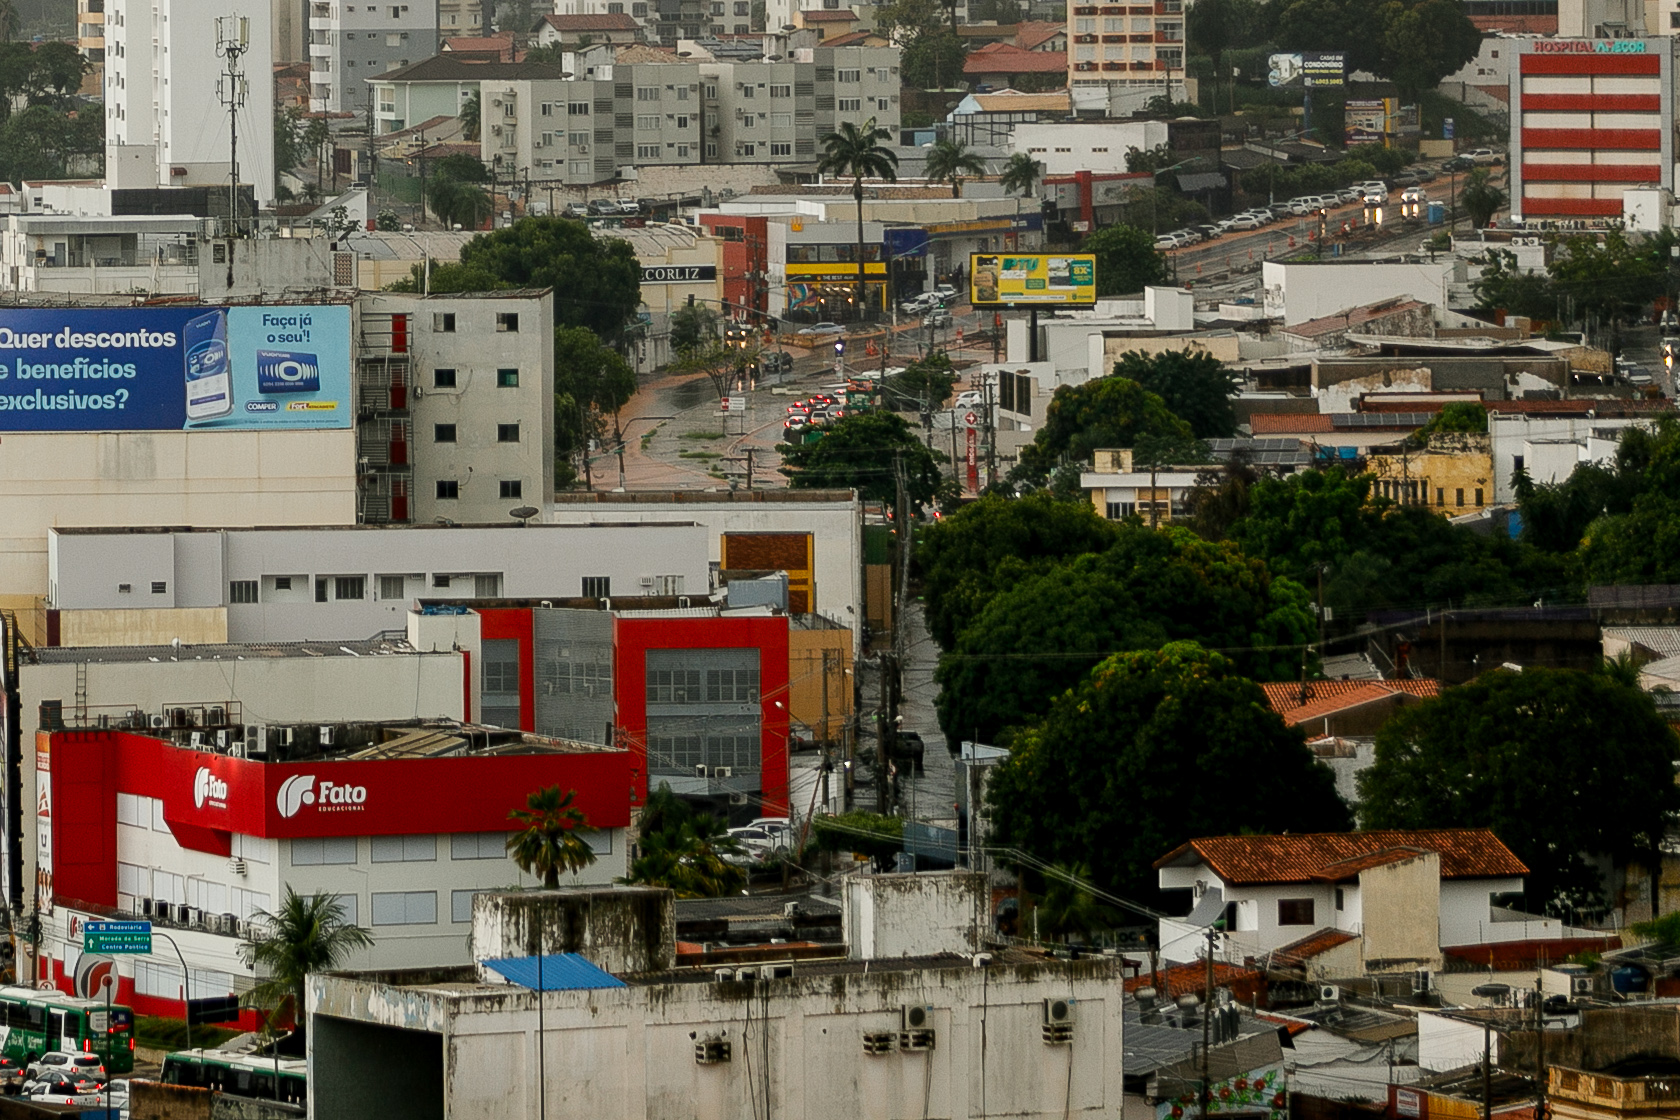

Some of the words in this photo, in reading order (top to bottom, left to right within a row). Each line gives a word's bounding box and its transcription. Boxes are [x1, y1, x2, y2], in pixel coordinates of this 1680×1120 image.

[1533, 41, 1594, 52] HOSPITAL
[262, 313, 297, 329] Faça
[299, 313, 312, 329] já
[54, 326, 177, 348] descontos
[266, 335, 276, 343] o
[16, 357, 137, 379] benefícios
[247, 402, 278, 411] COMPER
[208, 775, 227, 799] Fato
[319, 781, 367, 804] Fato
